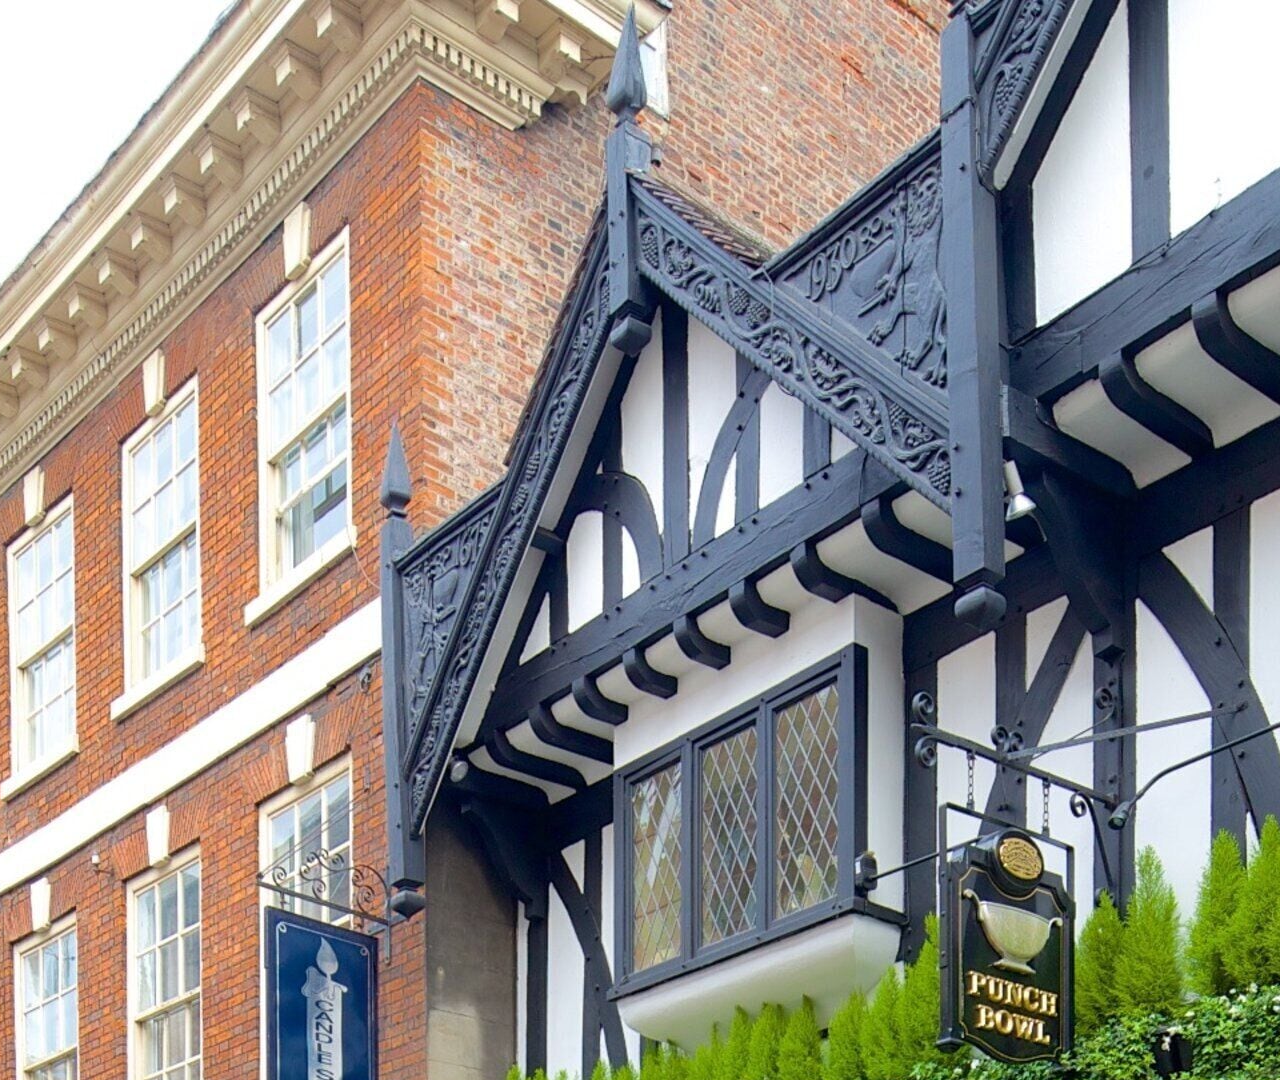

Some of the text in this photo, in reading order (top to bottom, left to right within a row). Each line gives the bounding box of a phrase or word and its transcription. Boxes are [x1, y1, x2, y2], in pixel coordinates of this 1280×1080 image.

[967, 970, 1059, 1017] PUNCH
[314, 1000, 334, 1065] CANDLE
[975, 1003, 1051, 1046] BOWL
